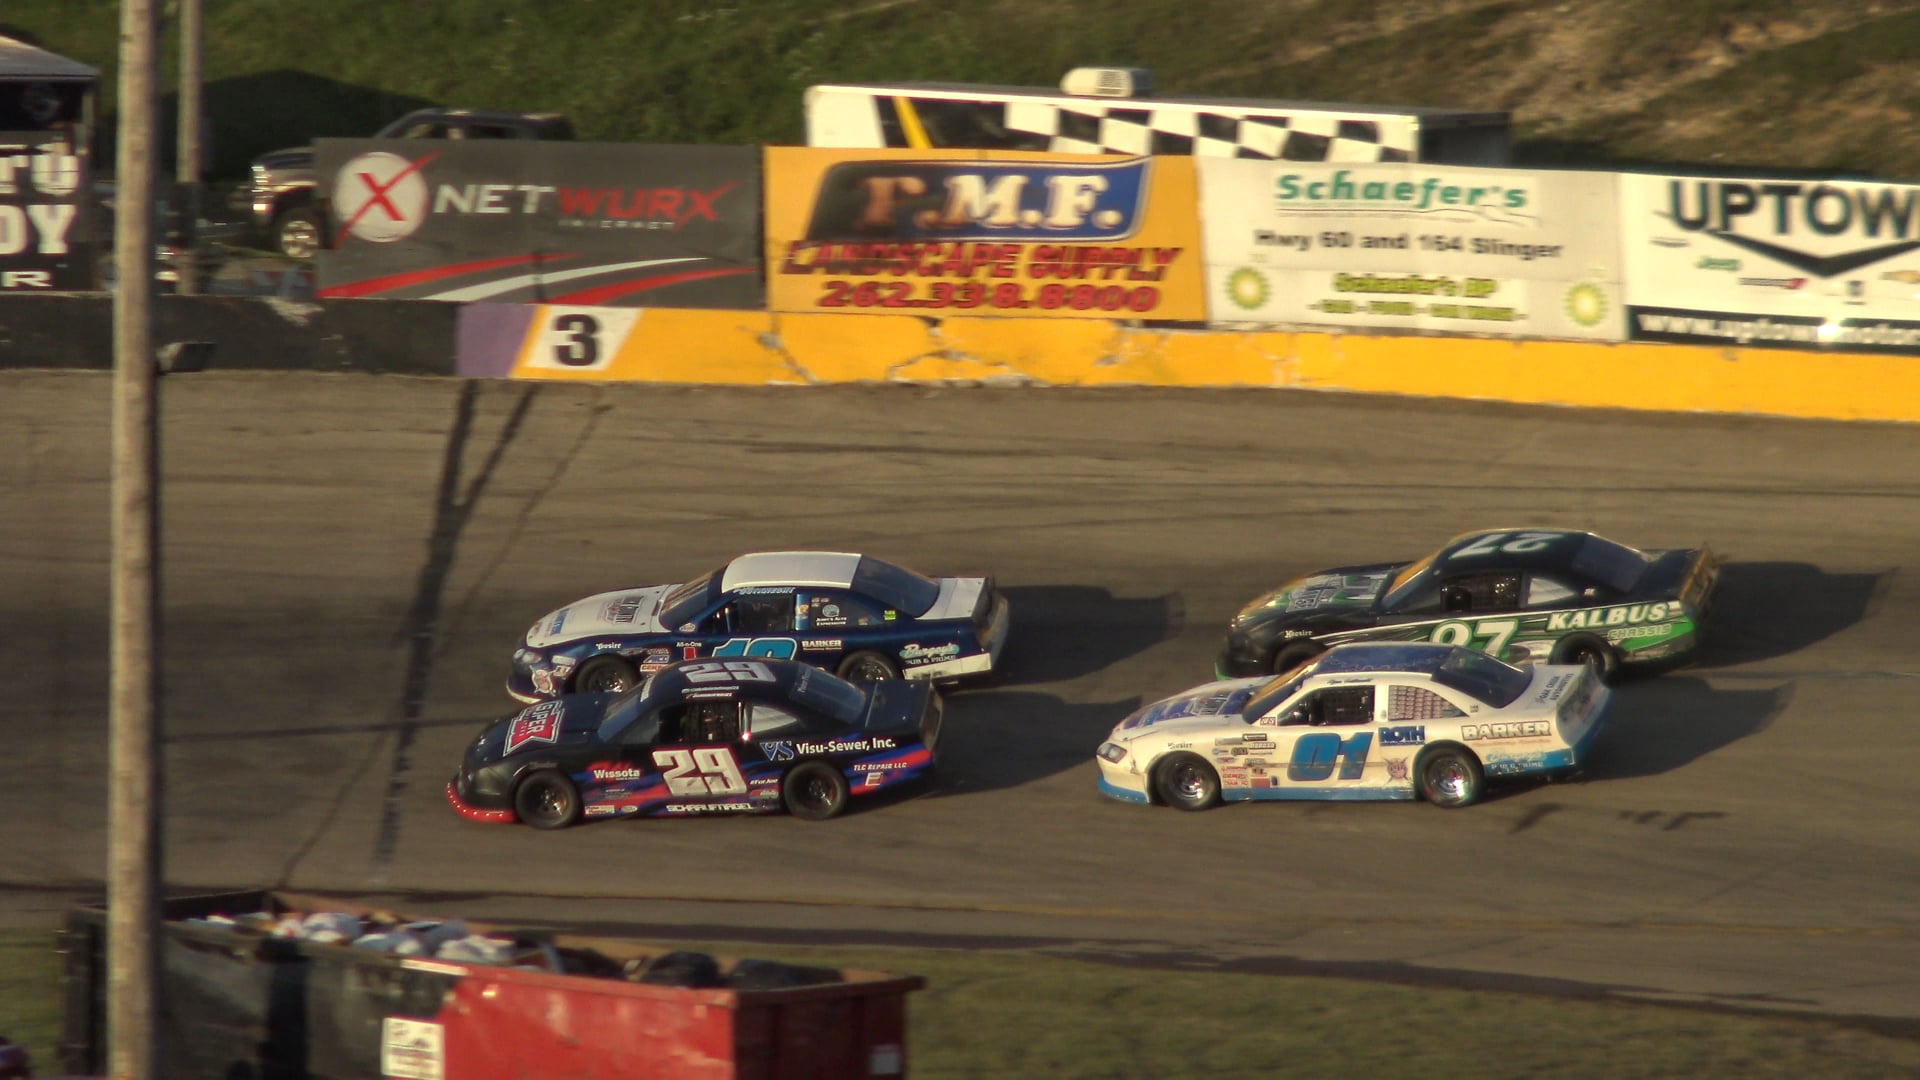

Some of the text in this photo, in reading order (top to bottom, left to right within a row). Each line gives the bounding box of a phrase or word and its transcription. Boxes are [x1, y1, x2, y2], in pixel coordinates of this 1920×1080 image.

[1275, 170, 1527, 208] Schaefer's
[433, 182, 738, 224] NETWURX
[1255, 230, 1563, 261] Hwy 60 and 164 Slinger
[780, 241, 1184, 281] LANDSCAPE SUPPLY
[554, 313, 604, 367] 3
[1546, 602, 1668, 632] KALBUS
[802, 639, 842, 650] BARKER
[1607, 624, 1672, 640] CHASSIS
[678, 661, 776, 684] 29
[1461, 720, 1552, 741] BARKER
[796, 737, 896, 755] Visu-Sewer, Inc.
[594, 767, 641, 780] Wissota
[653, 748, 747, 796] 29
[868, 763, 893, 771] REPAIR
